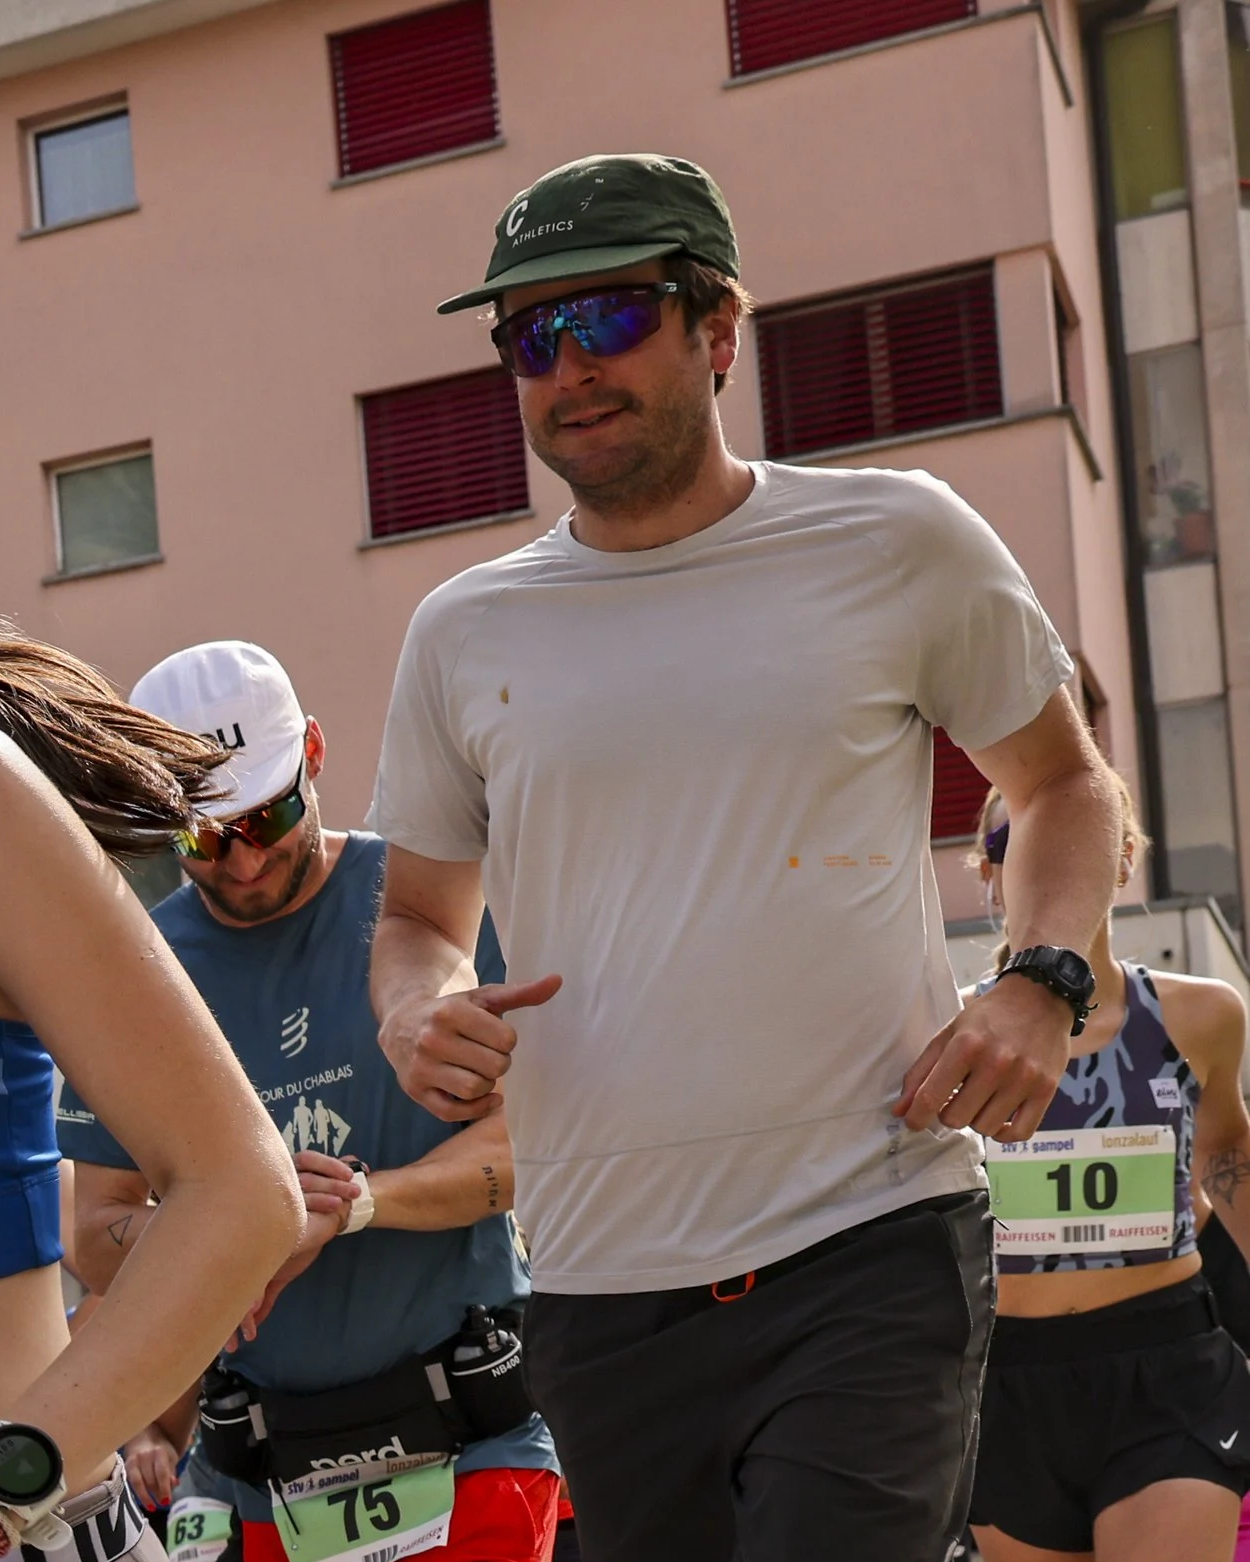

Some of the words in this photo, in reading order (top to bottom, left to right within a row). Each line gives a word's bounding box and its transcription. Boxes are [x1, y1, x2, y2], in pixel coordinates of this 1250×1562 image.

[512, 220, 574, 248] ATHLETICS
[258, 1086, 285, 1104] OUR
[286, 1081, 302, 1097] DU
[304, 1063, 354, 1091] CHABLAIS
[1001, 1141, 1017, 1153] stv
[1032, 1137, 1074, 1153] gampel
[1102, 1131, 1159, 1149] lonzalauf
[1046, 1161, 1118, 1212] 10
[996, 1231, 1056, 1243] RAIFFEISEN
[1109, 1225, 1169, 1238] RAIFFEISEN
[491, 1355, 520, 1378] NB400
[288, 1482, 304, 1495] stv
[327, 1479, 401, 1542] 75
[174, 1513, 205, 1545] 63
